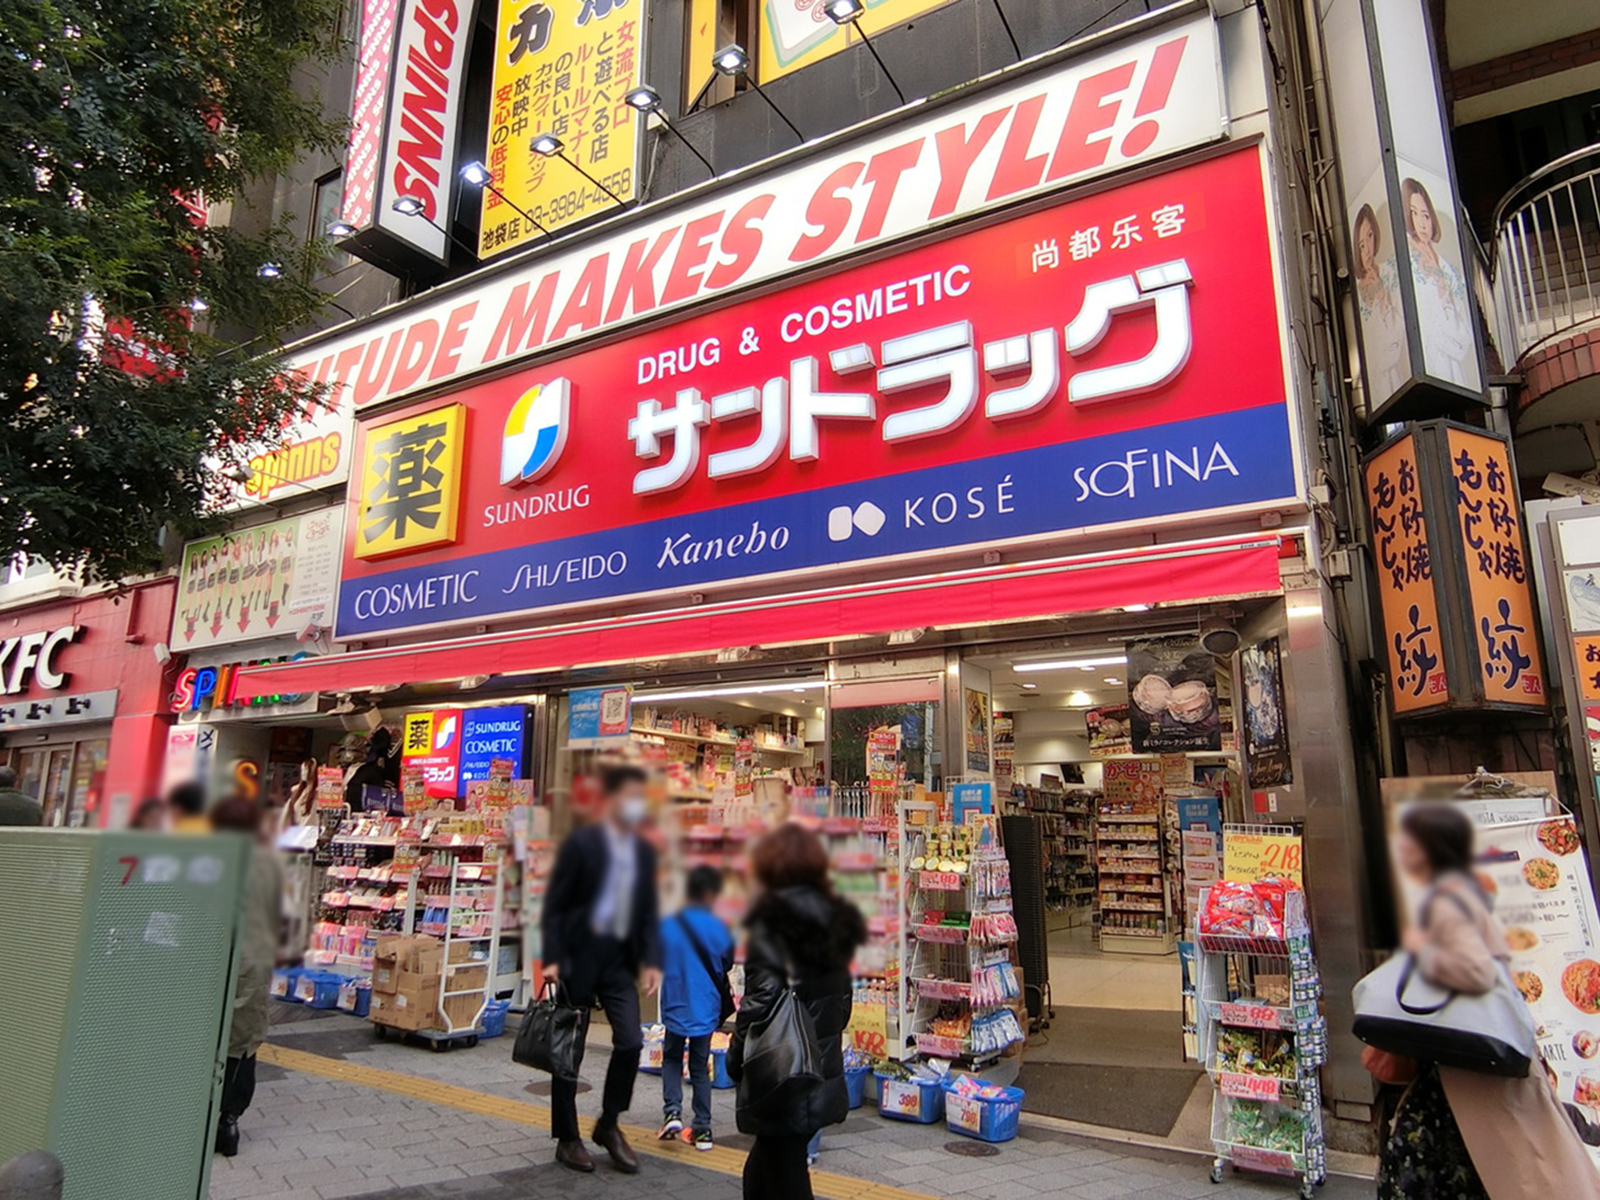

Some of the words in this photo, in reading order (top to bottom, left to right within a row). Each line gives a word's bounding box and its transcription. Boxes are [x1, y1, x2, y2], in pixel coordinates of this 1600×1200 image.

[511, 74, 532, 138] 放映中
[552, 52, 573, 137] の良い店
[569, 43, 594, 171] ルールマナー
[590, 31, 614, 164] と遊べる店
[613, 20, 636, 129] 女流プロ
[481, 194, 776, 364] MAKES
[788, 36, 1189, 262] STYLE!
[482, 217, 521, 252] 池袋店
[524, 167, 631, 235] 03-3984-4558
[1031, 204, 1186, 273] 尚都乐客
[637, 337, 720, 385] DRUG
[738, 326, 760, 355] &
[780, 264, 972, 344] COSMETIC
[628, 258, 1194, 497] サンドラッグ
[245, 431, 342, 500] spinns
[363, 422, 447, 544] 薬
[482, 484, 591, 528] SUNDRUG
[1453, 448, 1492, 579] もんじゃ
[354, 569, 479, 620] COSMETIC
[502, 550, 628, 594] SHISEIDO
[657, 520, 790, 569] Kanebo
[905, 476, 1015, 529] KOSÉ
[1073, 441, 1240, 503] SOFINA
[1373, 472, 1404, 592] もんじゃ
[1398, 458, 1432, 584] お好焼
[1486, 455, 1526, 584] お好焼
[409, 719, 430, 750] 薬
[465, 738, 517, 755] COSMETIC
[475, 720, 521, 735] SUNDRUG
[1265, 843, 1301, 870] 218
[898, 1093, 918, 1108] 398
[961, 1108, 977, 1124] 798
